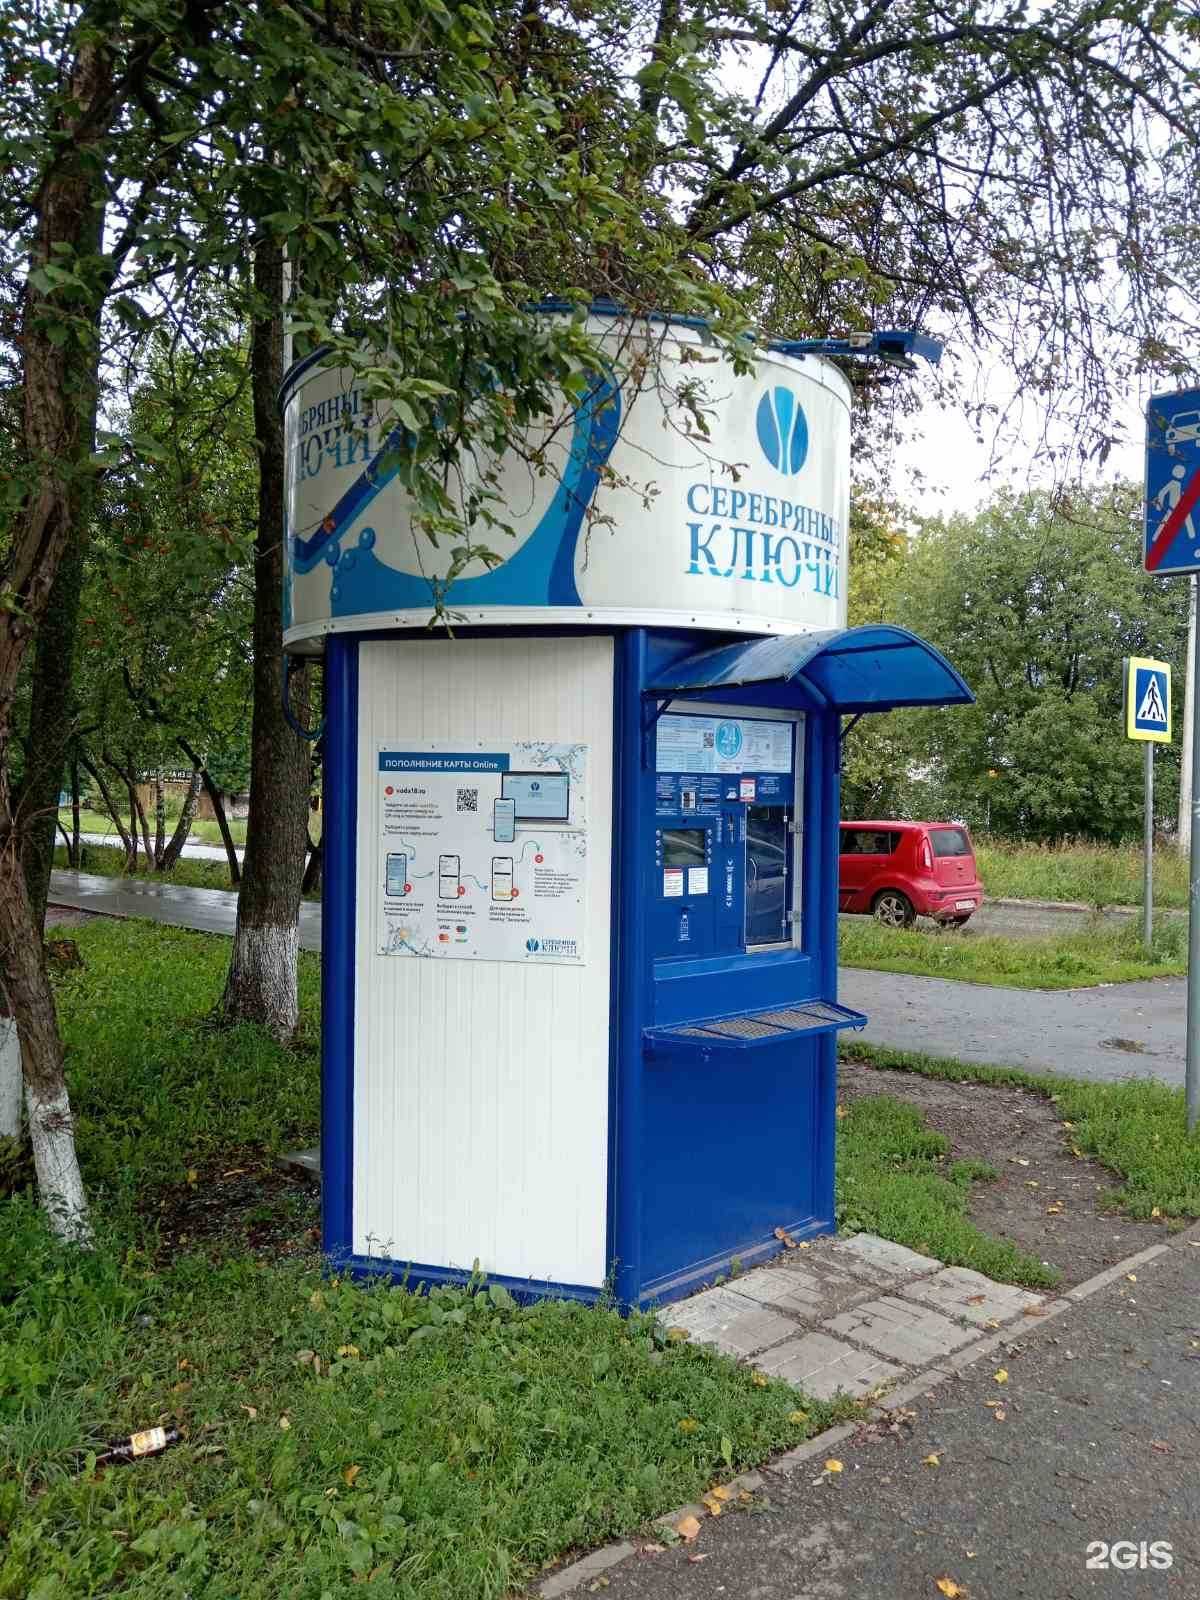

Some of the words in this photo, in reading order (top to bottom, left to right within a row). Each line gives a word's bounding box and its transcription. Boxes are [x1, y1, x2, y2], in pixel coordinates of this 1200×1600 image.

[685, 522, 840, 600] КЛЮЧИ
[385, 759, 443, 769] ПОПОЛНЕНИЕ
[444, 760, 471, 769] КАРТЫ
[472, 761, 499, 770] Online
